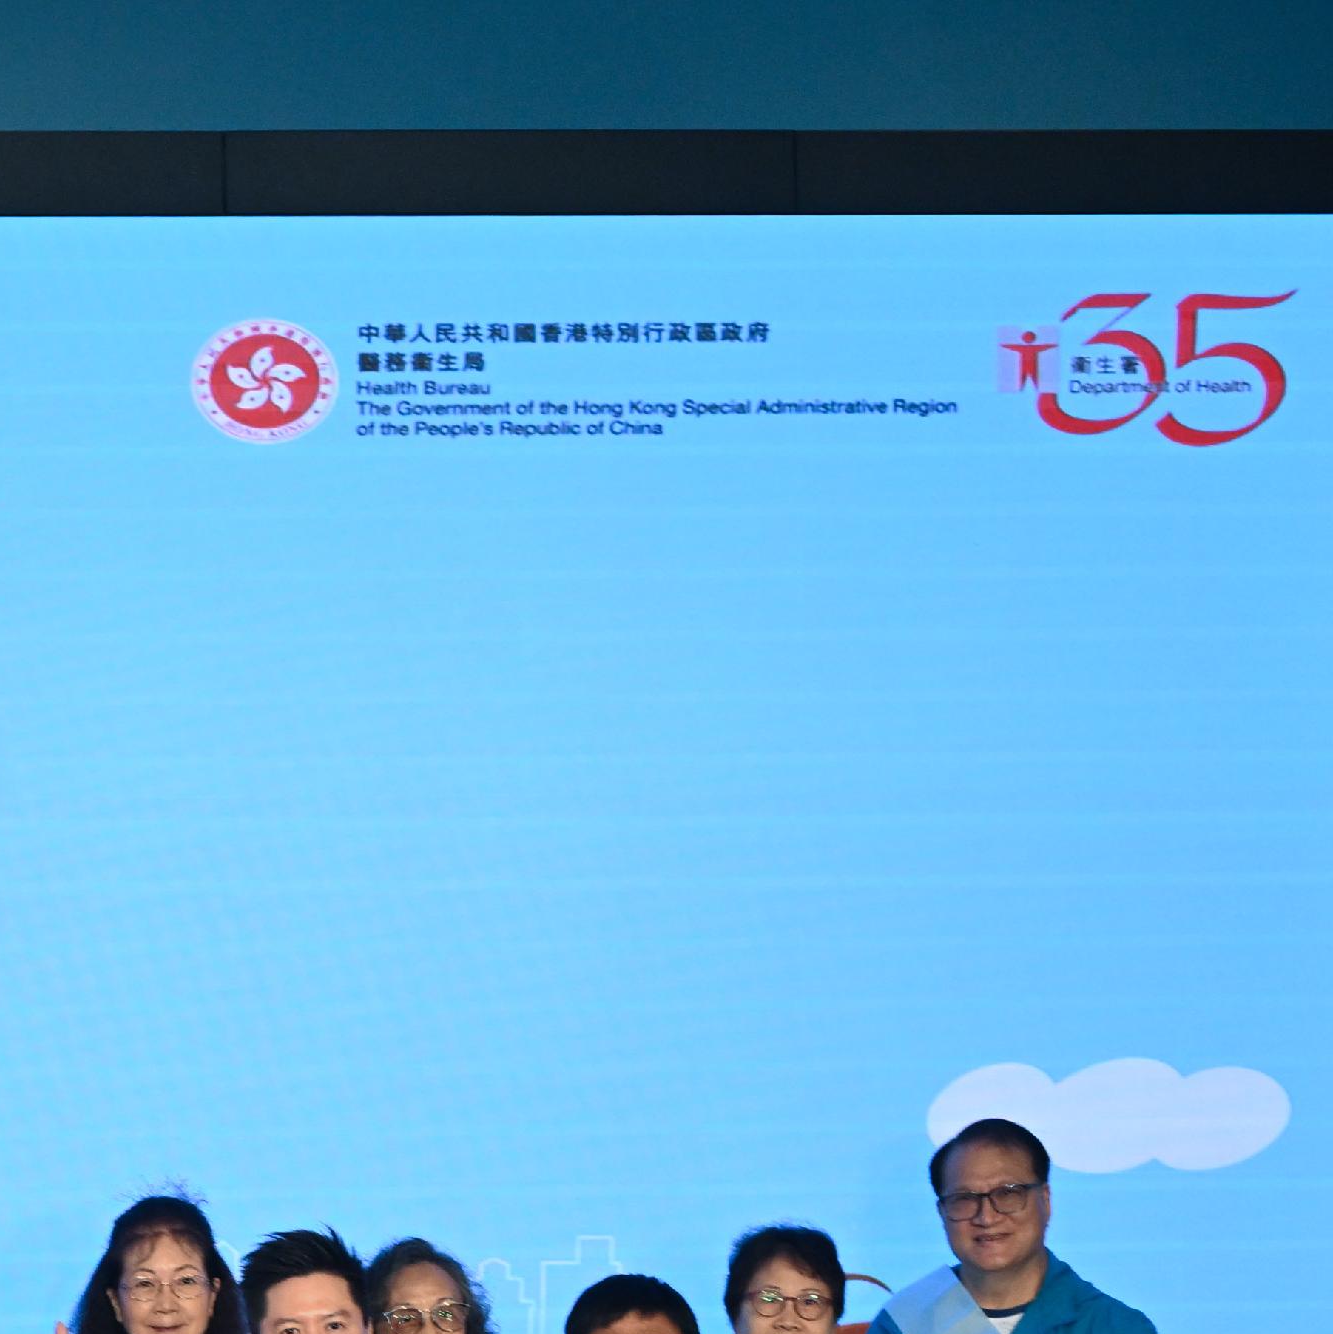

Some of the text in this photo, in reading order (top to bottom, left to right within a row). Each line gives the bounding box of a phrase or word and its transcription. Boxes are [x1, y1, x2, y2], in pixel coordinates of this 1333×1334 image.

[358, 321, 770, 344] 中華人民共和國香港特別行政區政府
[357, 380, 491, 396] Health Bureau
[1069, 379, 1252, 396] Department of Health
[357, 398, 957, 419] The Government of the Hong Kong Special Administrative Region
[356, 419, 664, 439] of the People's Republic of China
